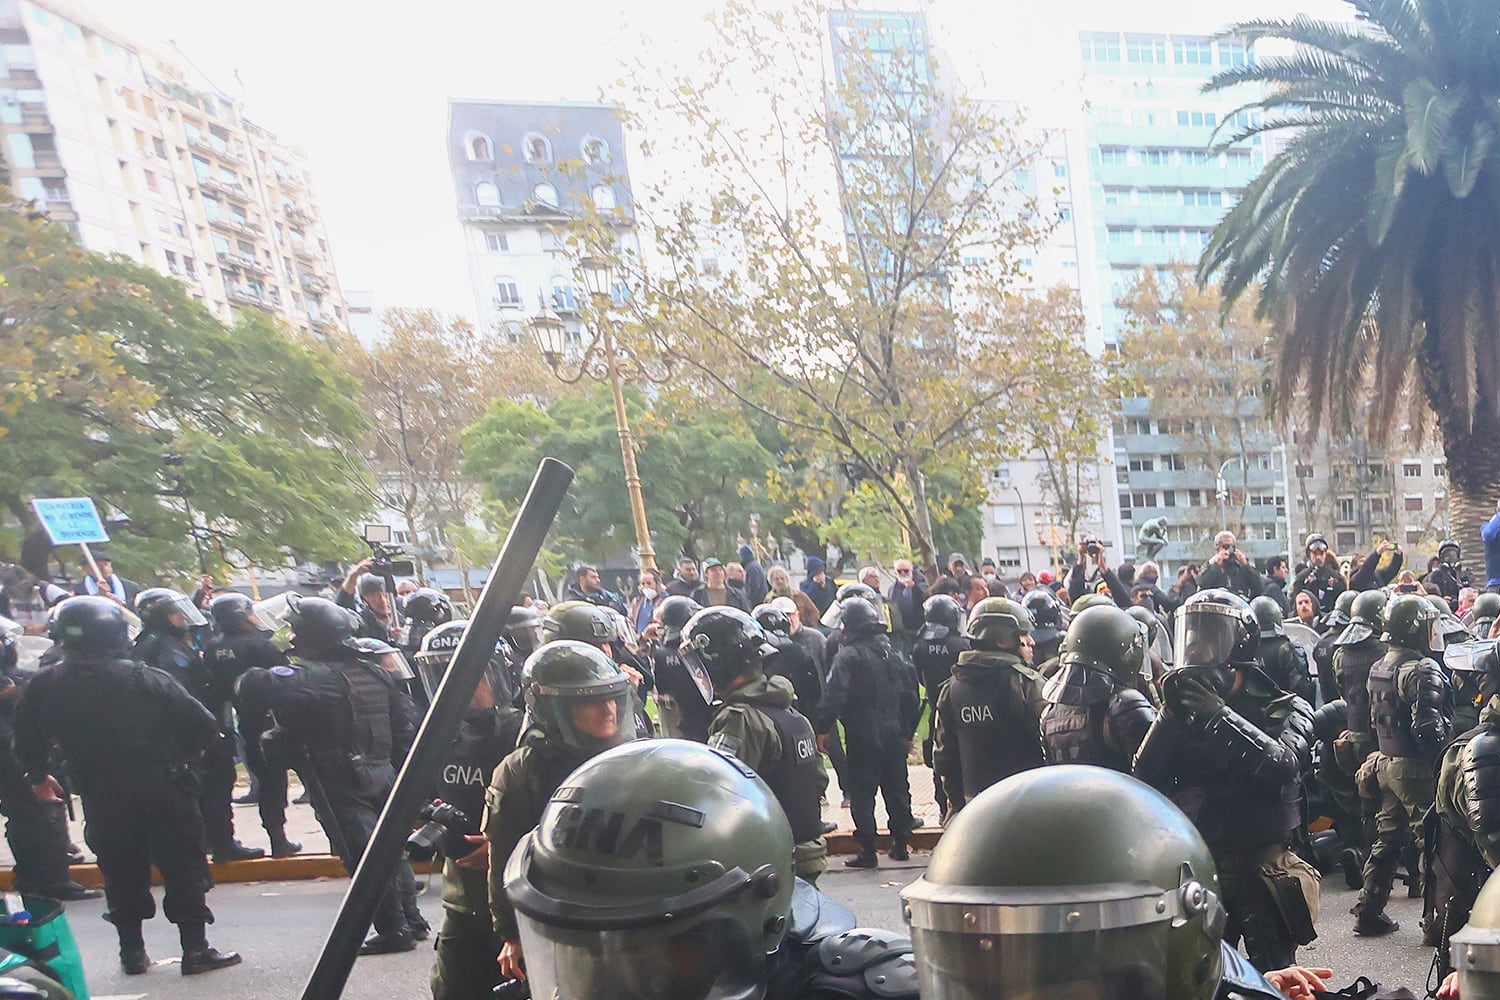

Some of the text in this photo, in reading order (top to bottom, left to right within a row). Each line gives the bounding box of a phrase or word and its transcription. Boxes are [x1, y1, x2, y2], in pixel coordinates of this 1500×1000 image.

[928, 644, 949, 655] PFA
[961, 704, 994, 724] GNA
[443, 764, 485, 787] GNA
